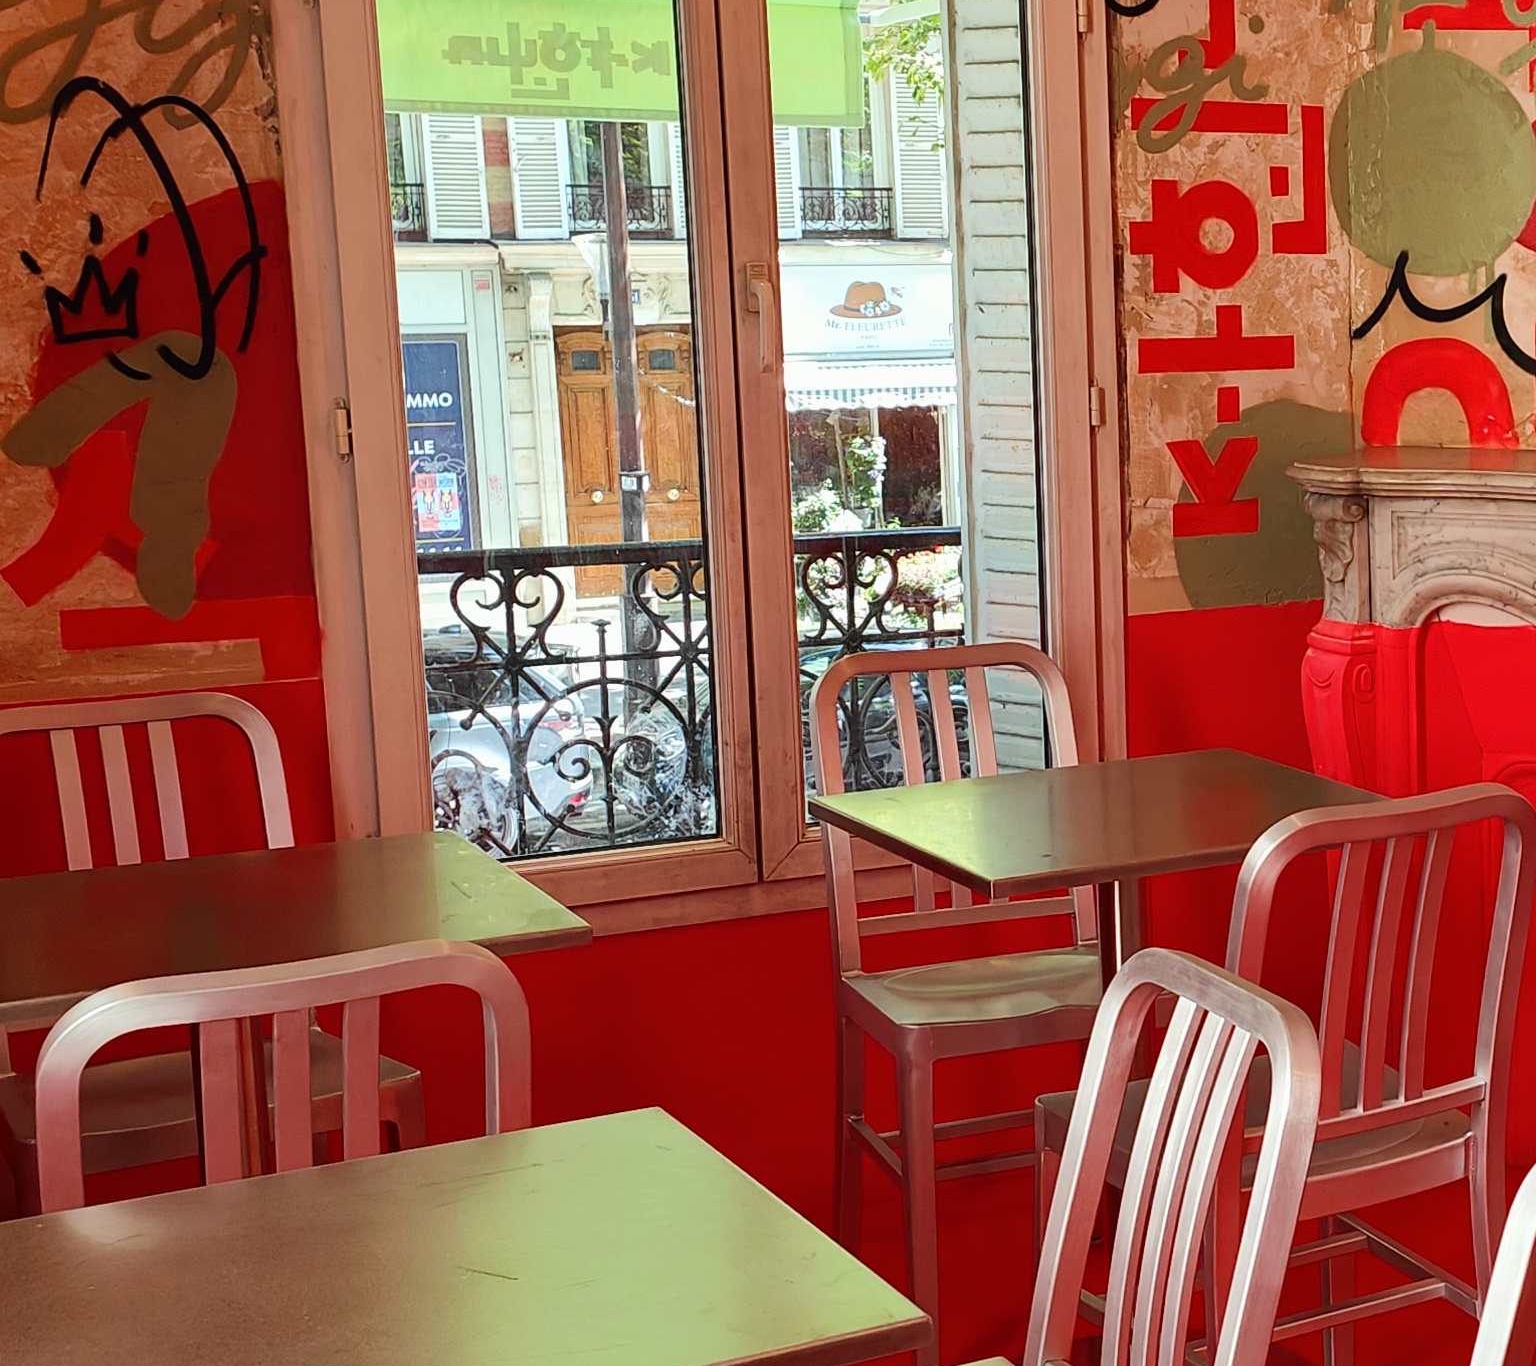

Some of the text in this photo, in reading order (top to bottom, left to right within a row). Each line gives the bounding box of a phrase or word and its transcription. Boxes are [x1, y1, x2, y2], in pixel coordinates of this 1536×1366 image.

[844, 316, 908, 332] FLEURETTE
[405, 392, 453, 409] MMO
[408, 439, 435, 456] LE
